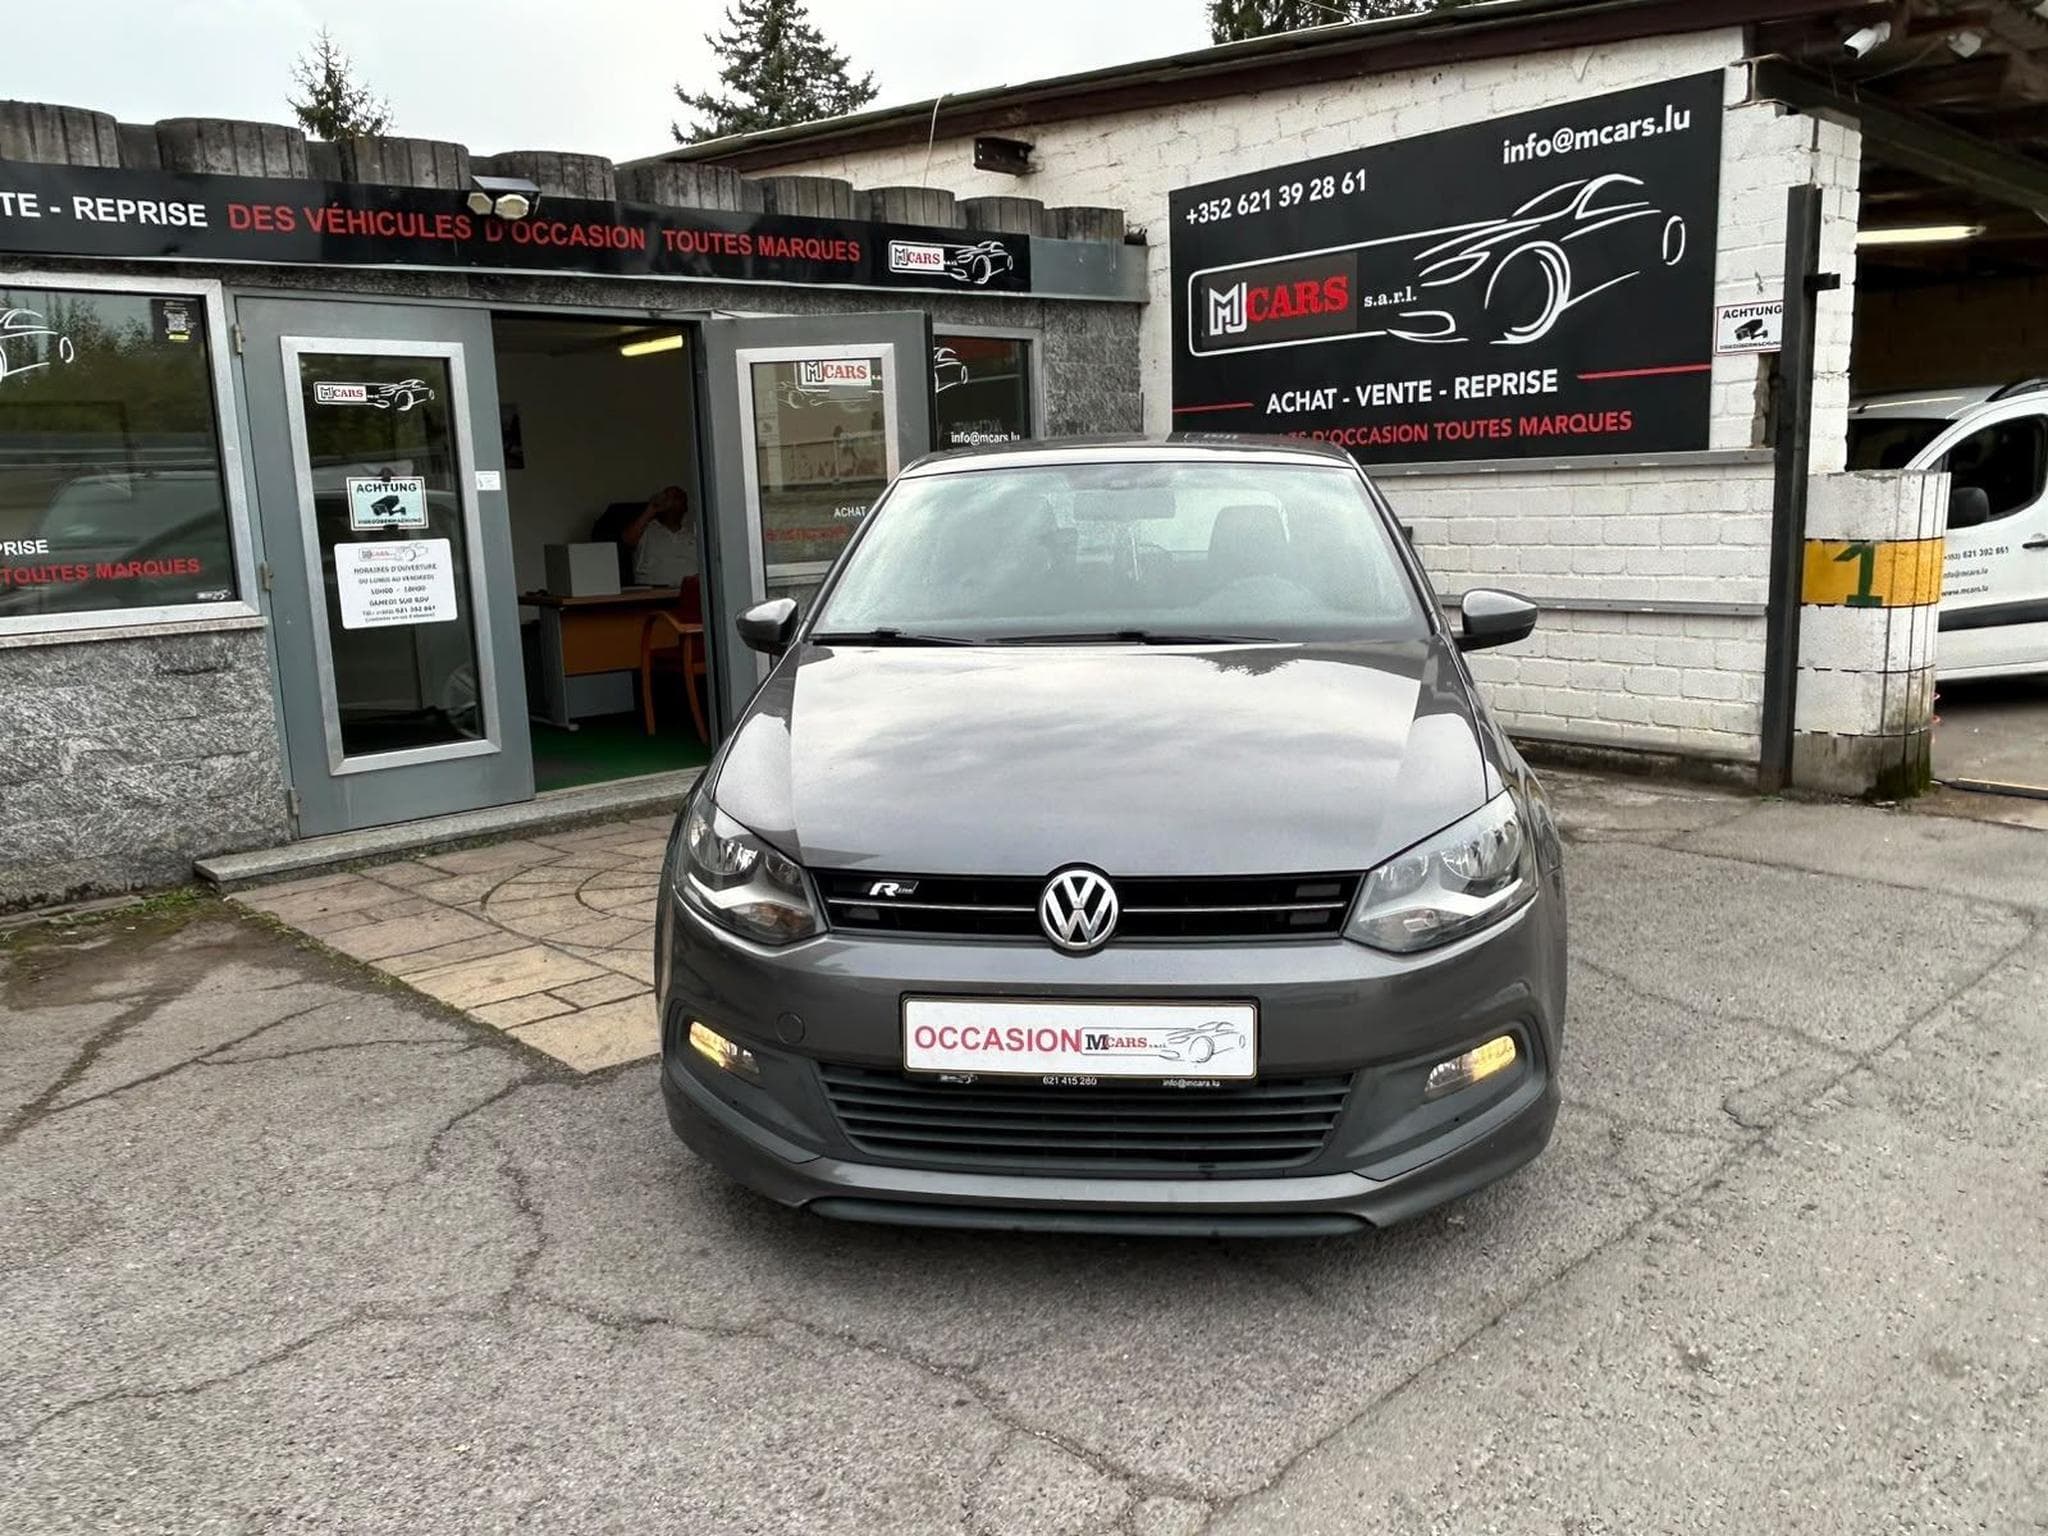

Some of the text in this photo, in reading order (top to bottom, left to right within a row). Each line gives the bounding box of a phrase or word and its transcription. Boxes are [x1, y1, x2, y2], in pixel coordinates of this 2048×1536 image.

[1503, 104, 1691, 165] info@mcars.lu
[1186, 168, 1366, 225] +352 621 39 28 61
[72, 196, 209, 227] REPRISE
[227, 204, 296, 232] DES
[303, 202, 472, 239] VÉHICULES
[484, 220, 646, 249] D'OCCASION
[662, 230, 751, 256] TOUTES
[757, 236, 861, 262] MARQUES
[1364, 286, 1417, 307] s.a.r.l.
[1722, 304, 1783, 319] ACHTUNG
[1266, 388, 1338, 414] ACHAT
[1355, 379, 1433, 407] VENTE
[1454, 368, 1559, 400] REPRISE
[950, 431, 1020, 446] info@mcarslu
[1433, 418, 1512, 441] TOUTES
[1518, 410, 1633, 436] MARQUES
[356, 483, 417, 493] ACHTUNG
[834, 506, 867, 518] ACHAT
[0, 539, 49, 556] RISE
[2, 559, 200, 585] TOUTES MARQUES
[1833, 543, 1883, 607] 1
[914, 1025, 1081, 1053] OCCASION
[1043, 1075, 1058, 1085] 621
[1061, 1075, 1077, 1086] 415
